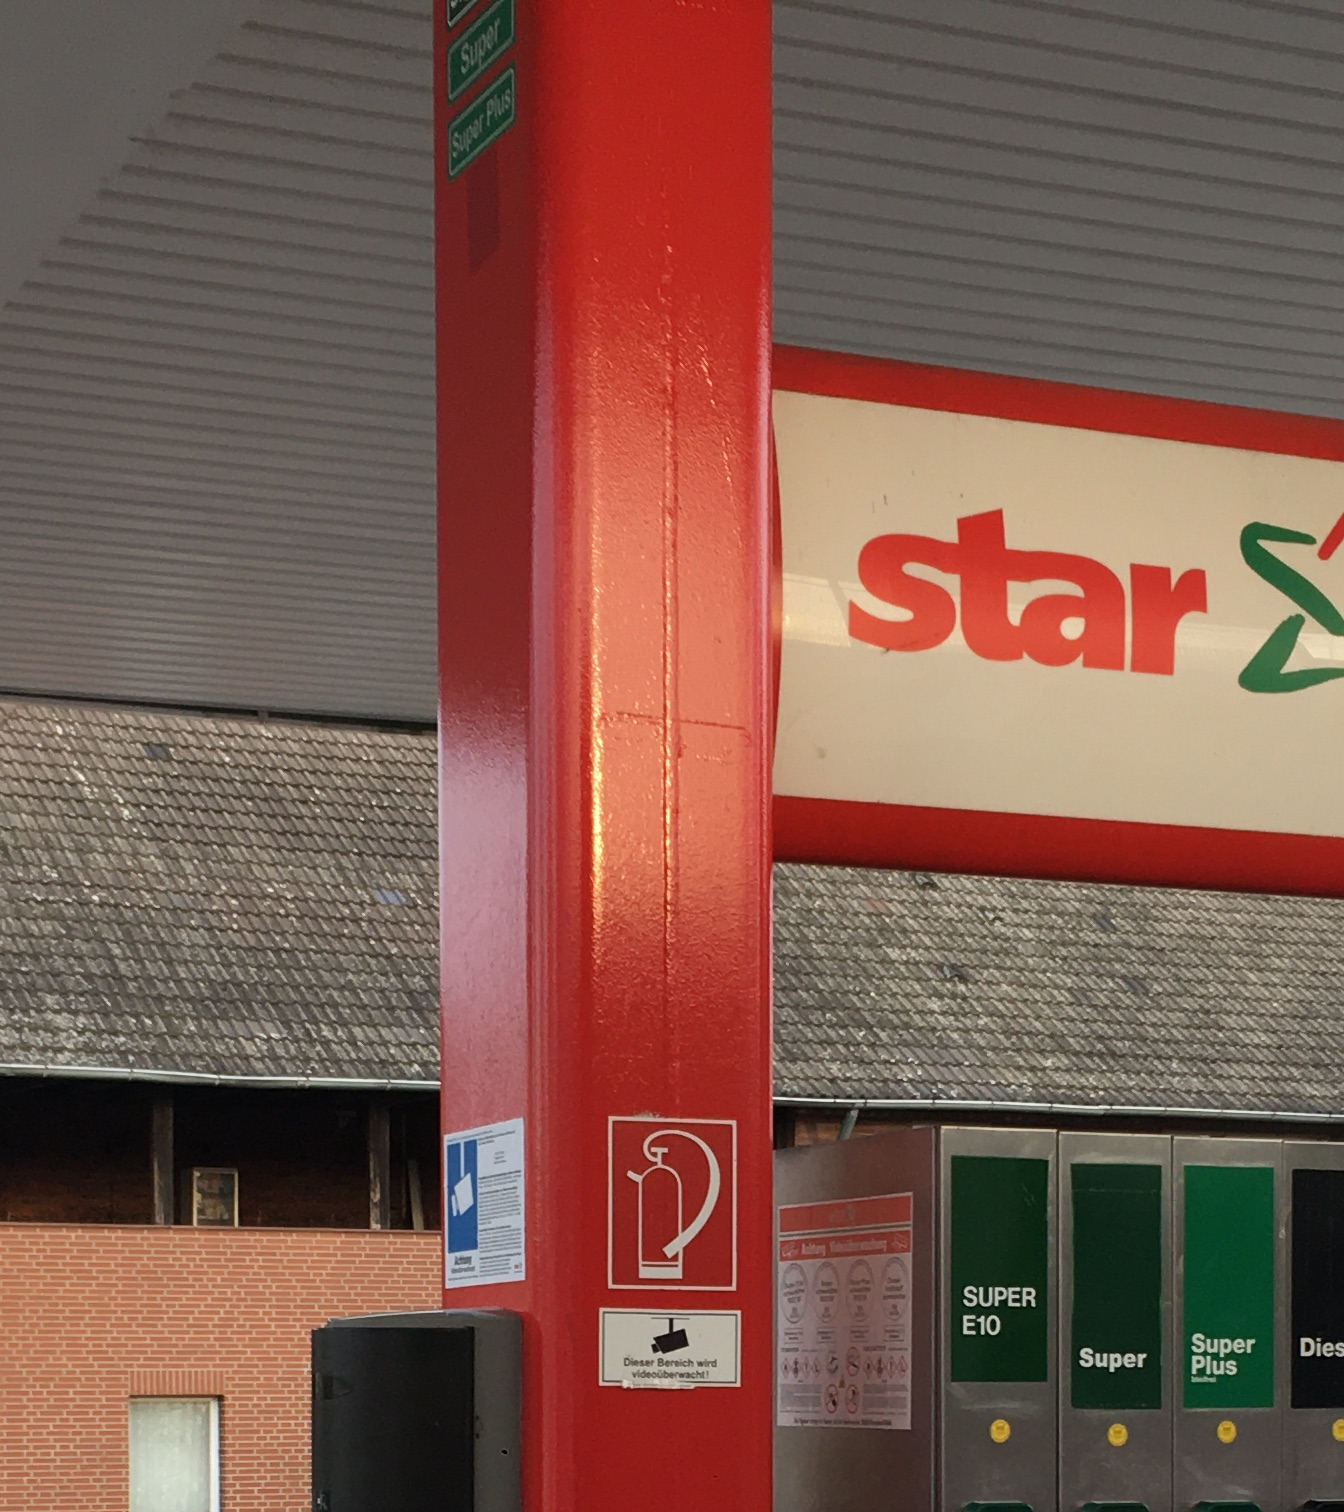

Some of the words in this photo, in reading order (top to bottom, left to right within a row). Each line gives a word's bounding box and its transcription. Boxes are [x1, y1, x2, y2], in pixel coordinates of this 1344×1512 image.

[460, 17, 501, 74] Super
[452, 113, 484, 158] Super
[486, 88, 511, 127] Plus
[847, 508, 1208, 675] star
[962, 1286, 1036, 1309] SUPER
[962, 1314, 1001, 1336] E10
[1191, 1332, 1256, 1358] Super
[623, 1357, 655, 1368] Dieser
[657, 1357, 694, 1368] Bereich
[696, 1358, 718, 1368] wird
[1078, 1347, 1147, 1373] Super
[1191, 1355, 1238, 1376] Plus
